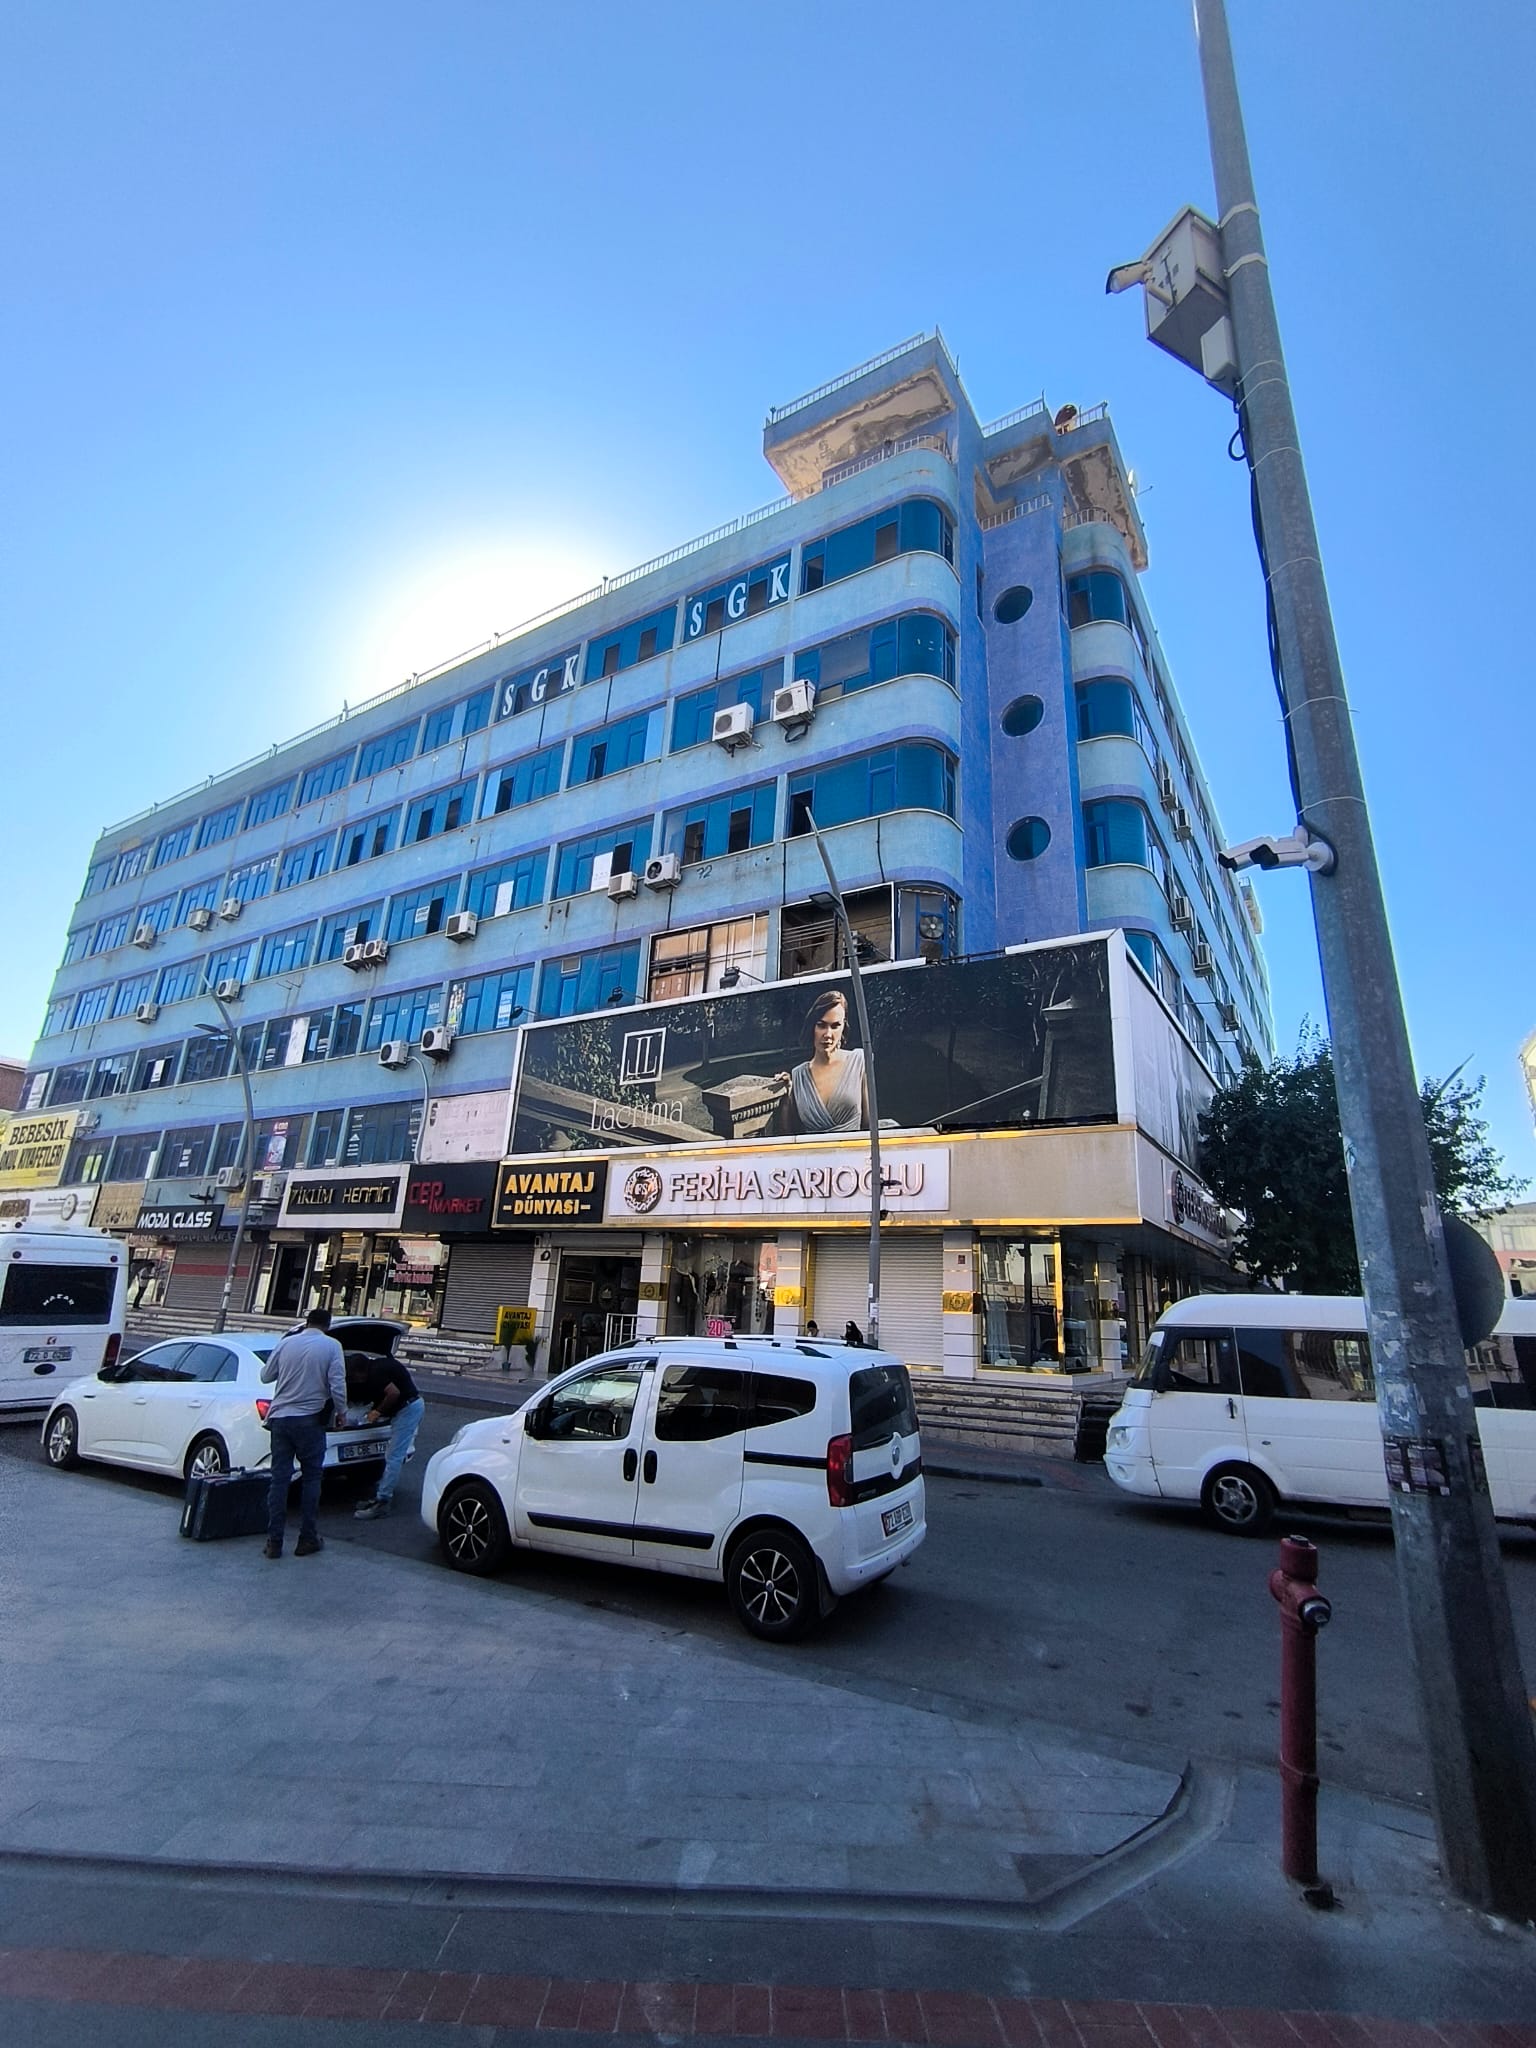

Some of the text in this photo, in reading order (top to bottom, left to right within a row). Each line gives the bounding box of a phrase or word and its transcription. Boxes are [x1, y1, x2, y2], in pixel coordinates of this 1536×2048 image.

[590, 1099, 682, 1131] Lacrima
[8, 1118, 69, 1146] BEBESİN
[409, 1181, 443, 1205] CEP
[504, 1171, 595, 1195] AVANTAJ
[670, 1165, 763, 1202] FERİHA
[429, 1197, 484, 1214] MARKET
[137, 1212, 170, 1229] MODA
[172, 1211, 214, 1228] CLASS
